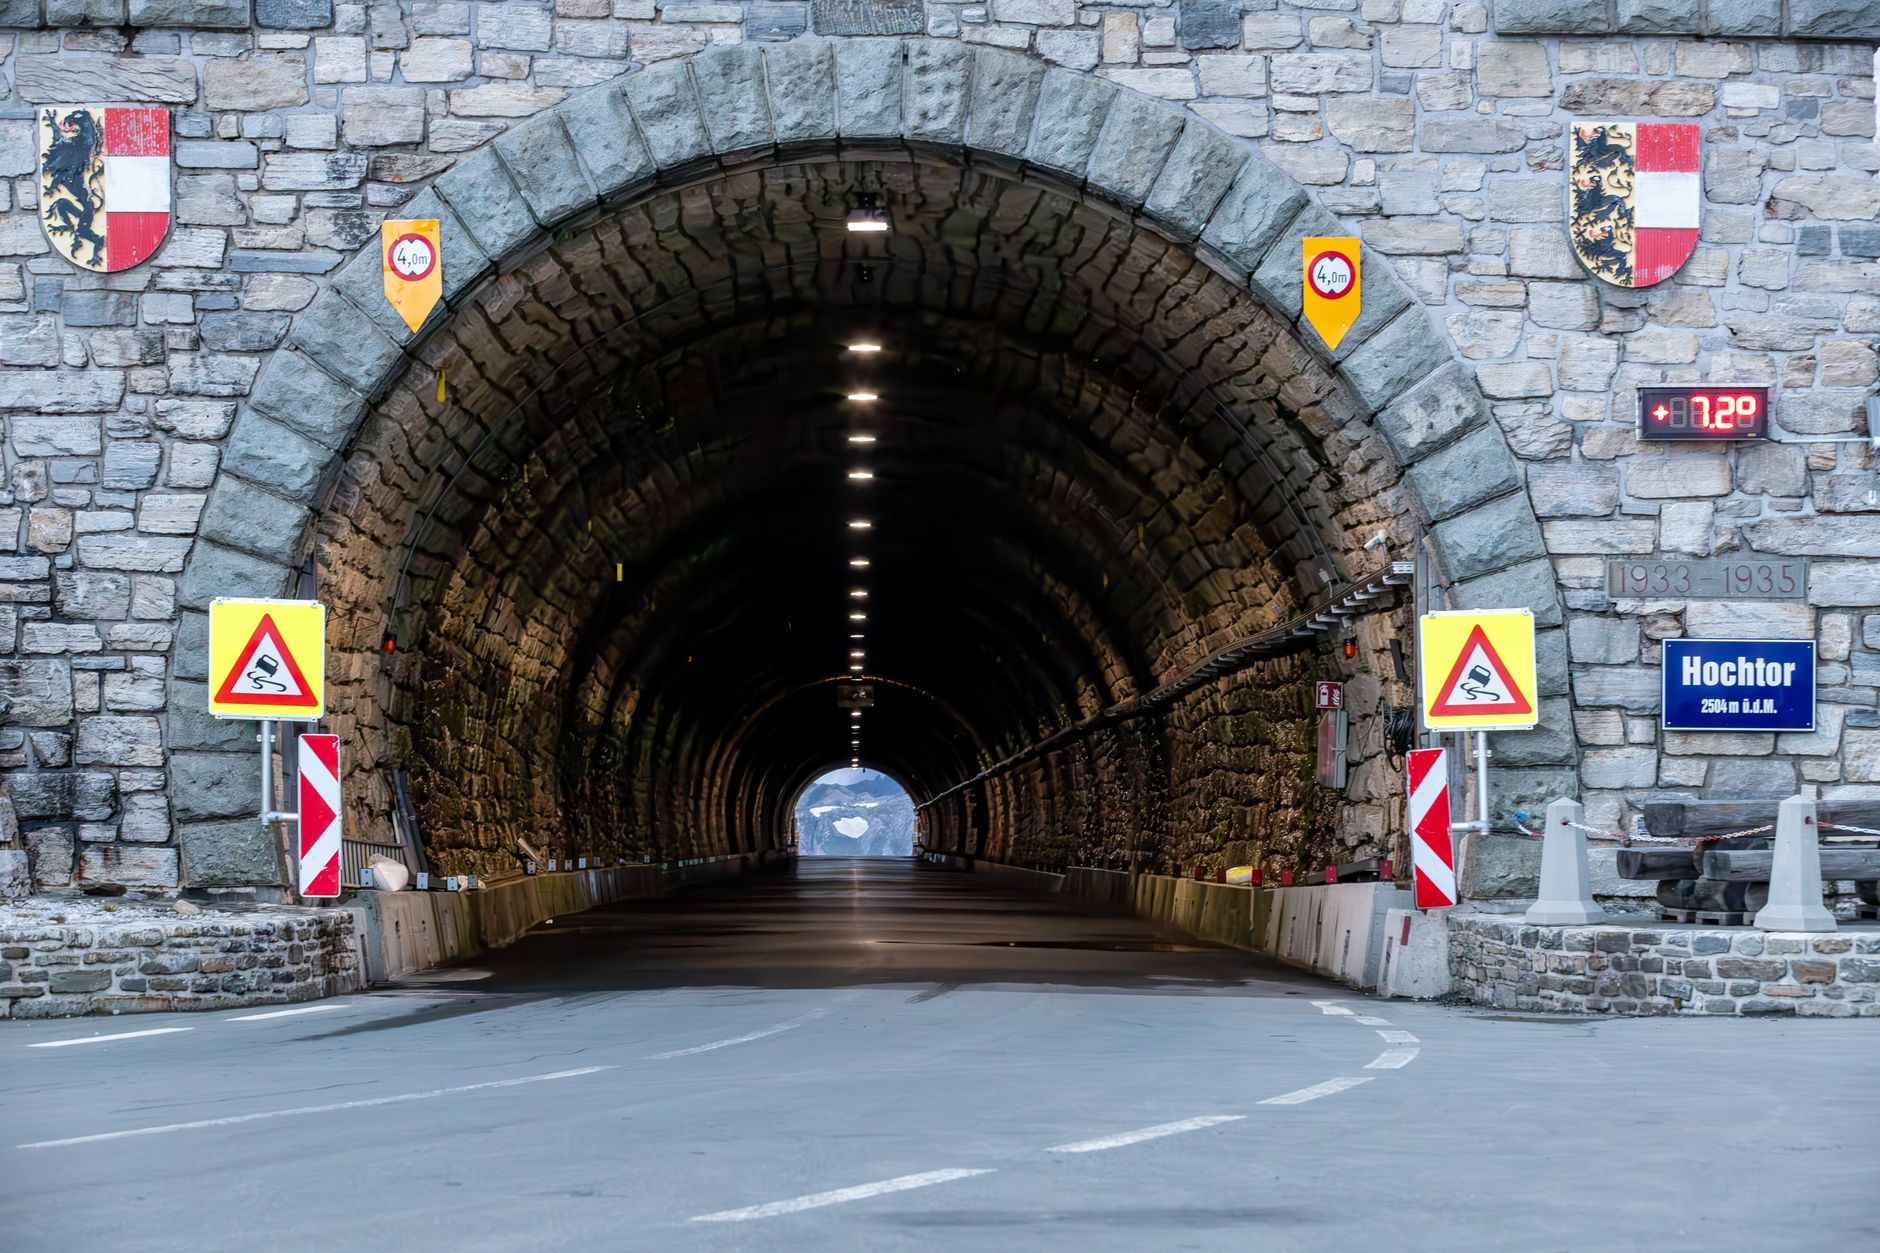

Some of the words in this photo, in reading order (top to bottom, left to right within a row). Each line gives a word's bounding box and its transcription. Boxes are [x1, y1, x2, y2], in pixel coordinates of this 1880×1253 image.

[397, 247, 428, 268] 4,0m
[1317, 265, 1348, 286] 4,0m
[1618, 564, 1691, 594] 1933
[1721, 564, 1796, 594] 1935
[1682, 655, 1796, 687] Hochtor
[1742, 698, 1778, 714] ü.d.M.
